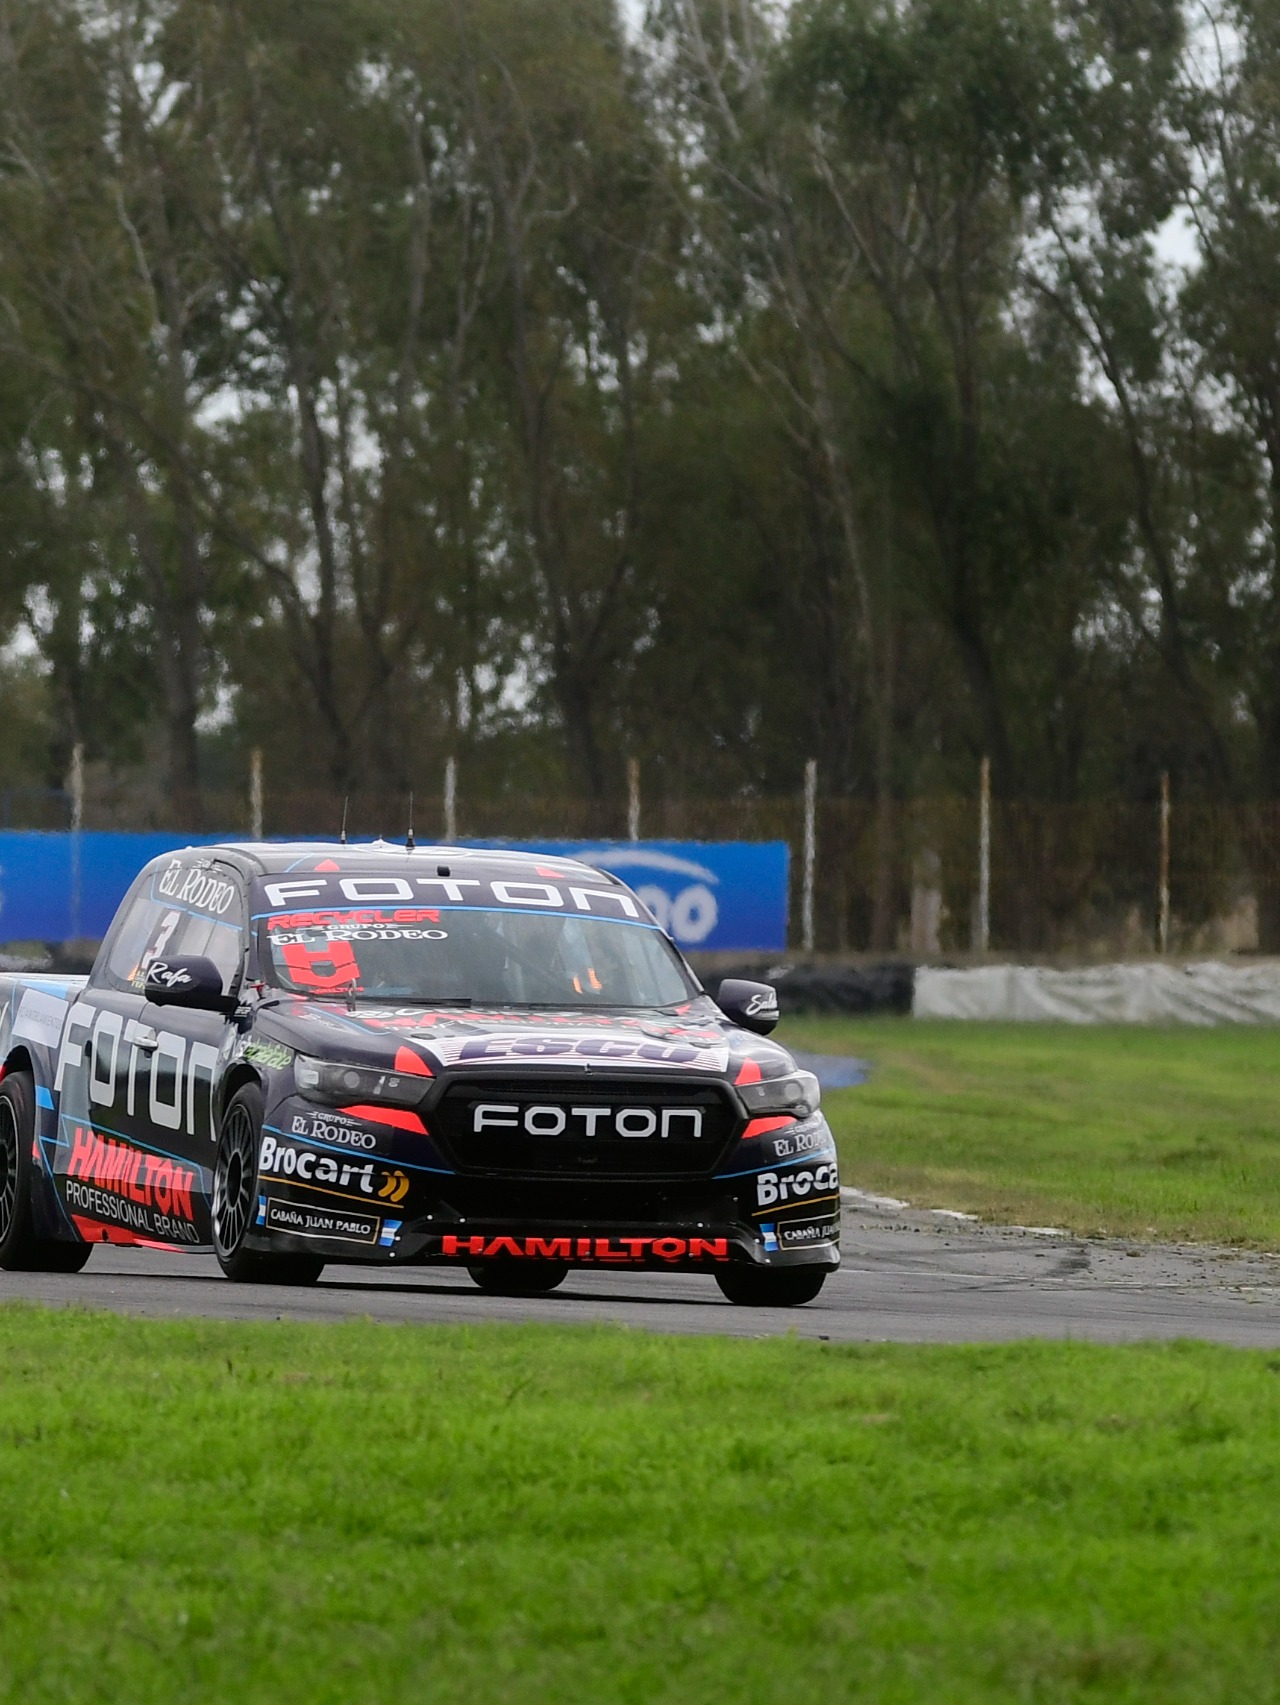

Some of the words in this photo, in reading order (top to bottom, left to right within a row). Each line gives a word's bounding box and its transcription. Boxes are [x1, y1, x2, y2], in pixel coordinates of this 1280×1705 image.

[176, 868, 235, 915] RODEO
[263, 877, 640, 918] FOTON
[267, 909, 442, 930] RECYCLER
[267, 932, 316, 946] EL
[321, 929, 449, 942] RODEO
[146, 961, 193, 987] Rafa
[291, 1115, 309, 1135] EL
[310, 1120, 377, 1149] RODEO
[473, 1104, 703, 1137] FOTON
[67, 1127, 195, 1221] HAMILTON
[258, 1136, 375, 1194] Brocart
[66, 1180, 155, 1234] PROFESSIONAL
[154, 1213, 200, 1244] BRAND
[270, 1208, 304, 1226] CABAÑA
[305, 1215, 334, 1229] JUAN
[335, 1220, 371, 1234] PABLO
[442, 1236, 730, 1260] HAMILTON
